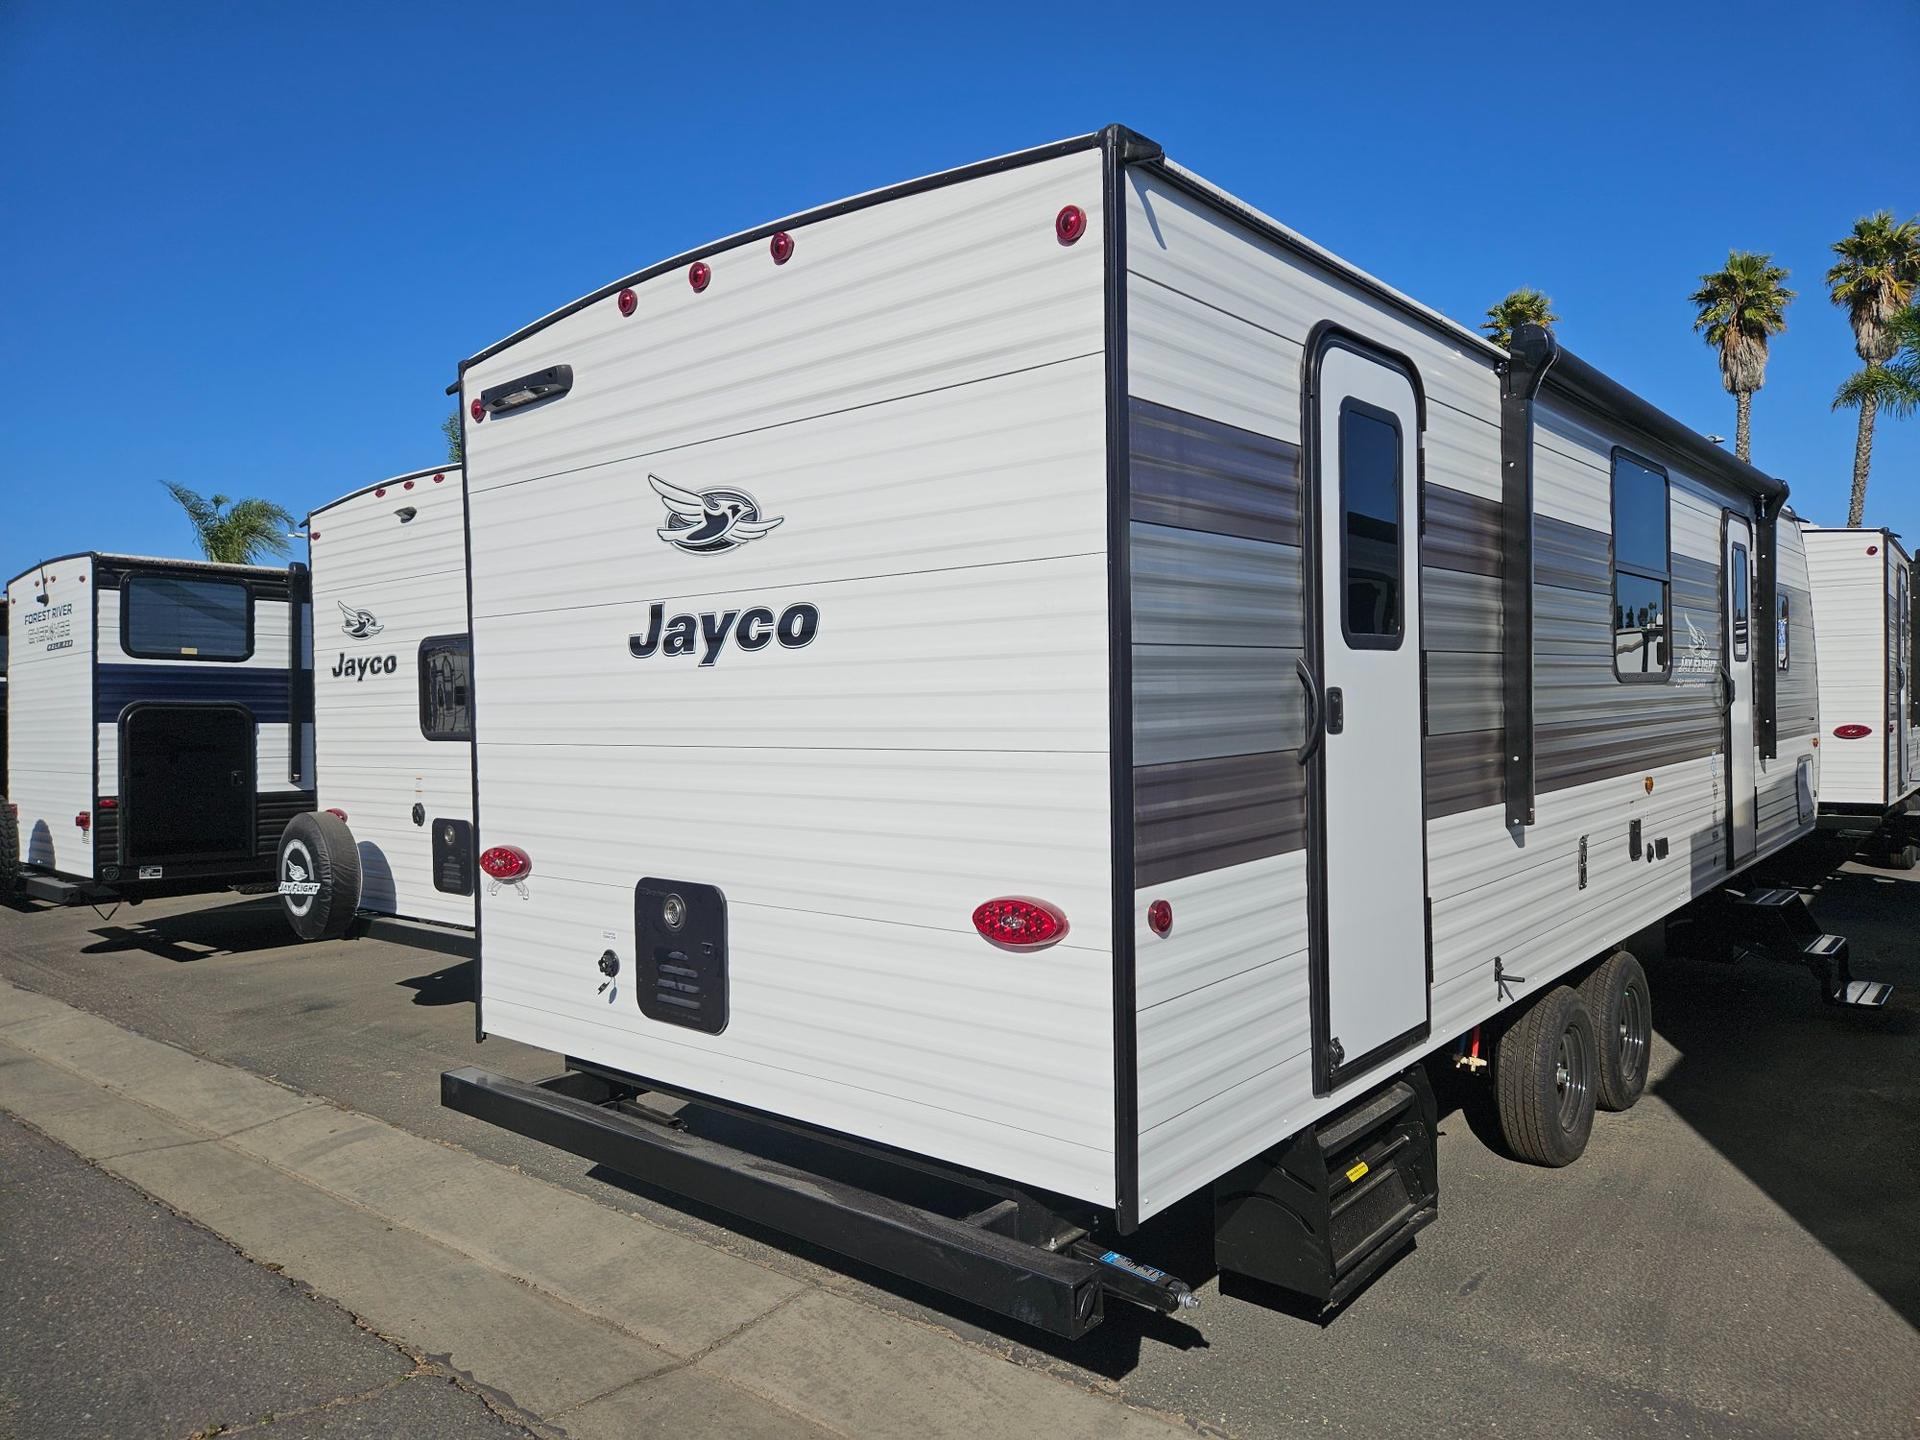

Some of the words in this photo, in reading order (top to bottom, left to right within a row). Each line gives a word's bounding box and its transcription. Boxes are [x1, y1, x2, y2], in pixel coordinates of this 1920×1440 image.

[25, 610, 51, 625] FOREST
[53, 604, 73, 618] RIVER
[628, 601, 821, 668] Jayco
[332, 652, 397, 682] Jayco
[279, 882, 291, 894] JAY
[292, 882, 320, 894] FLIGHT
